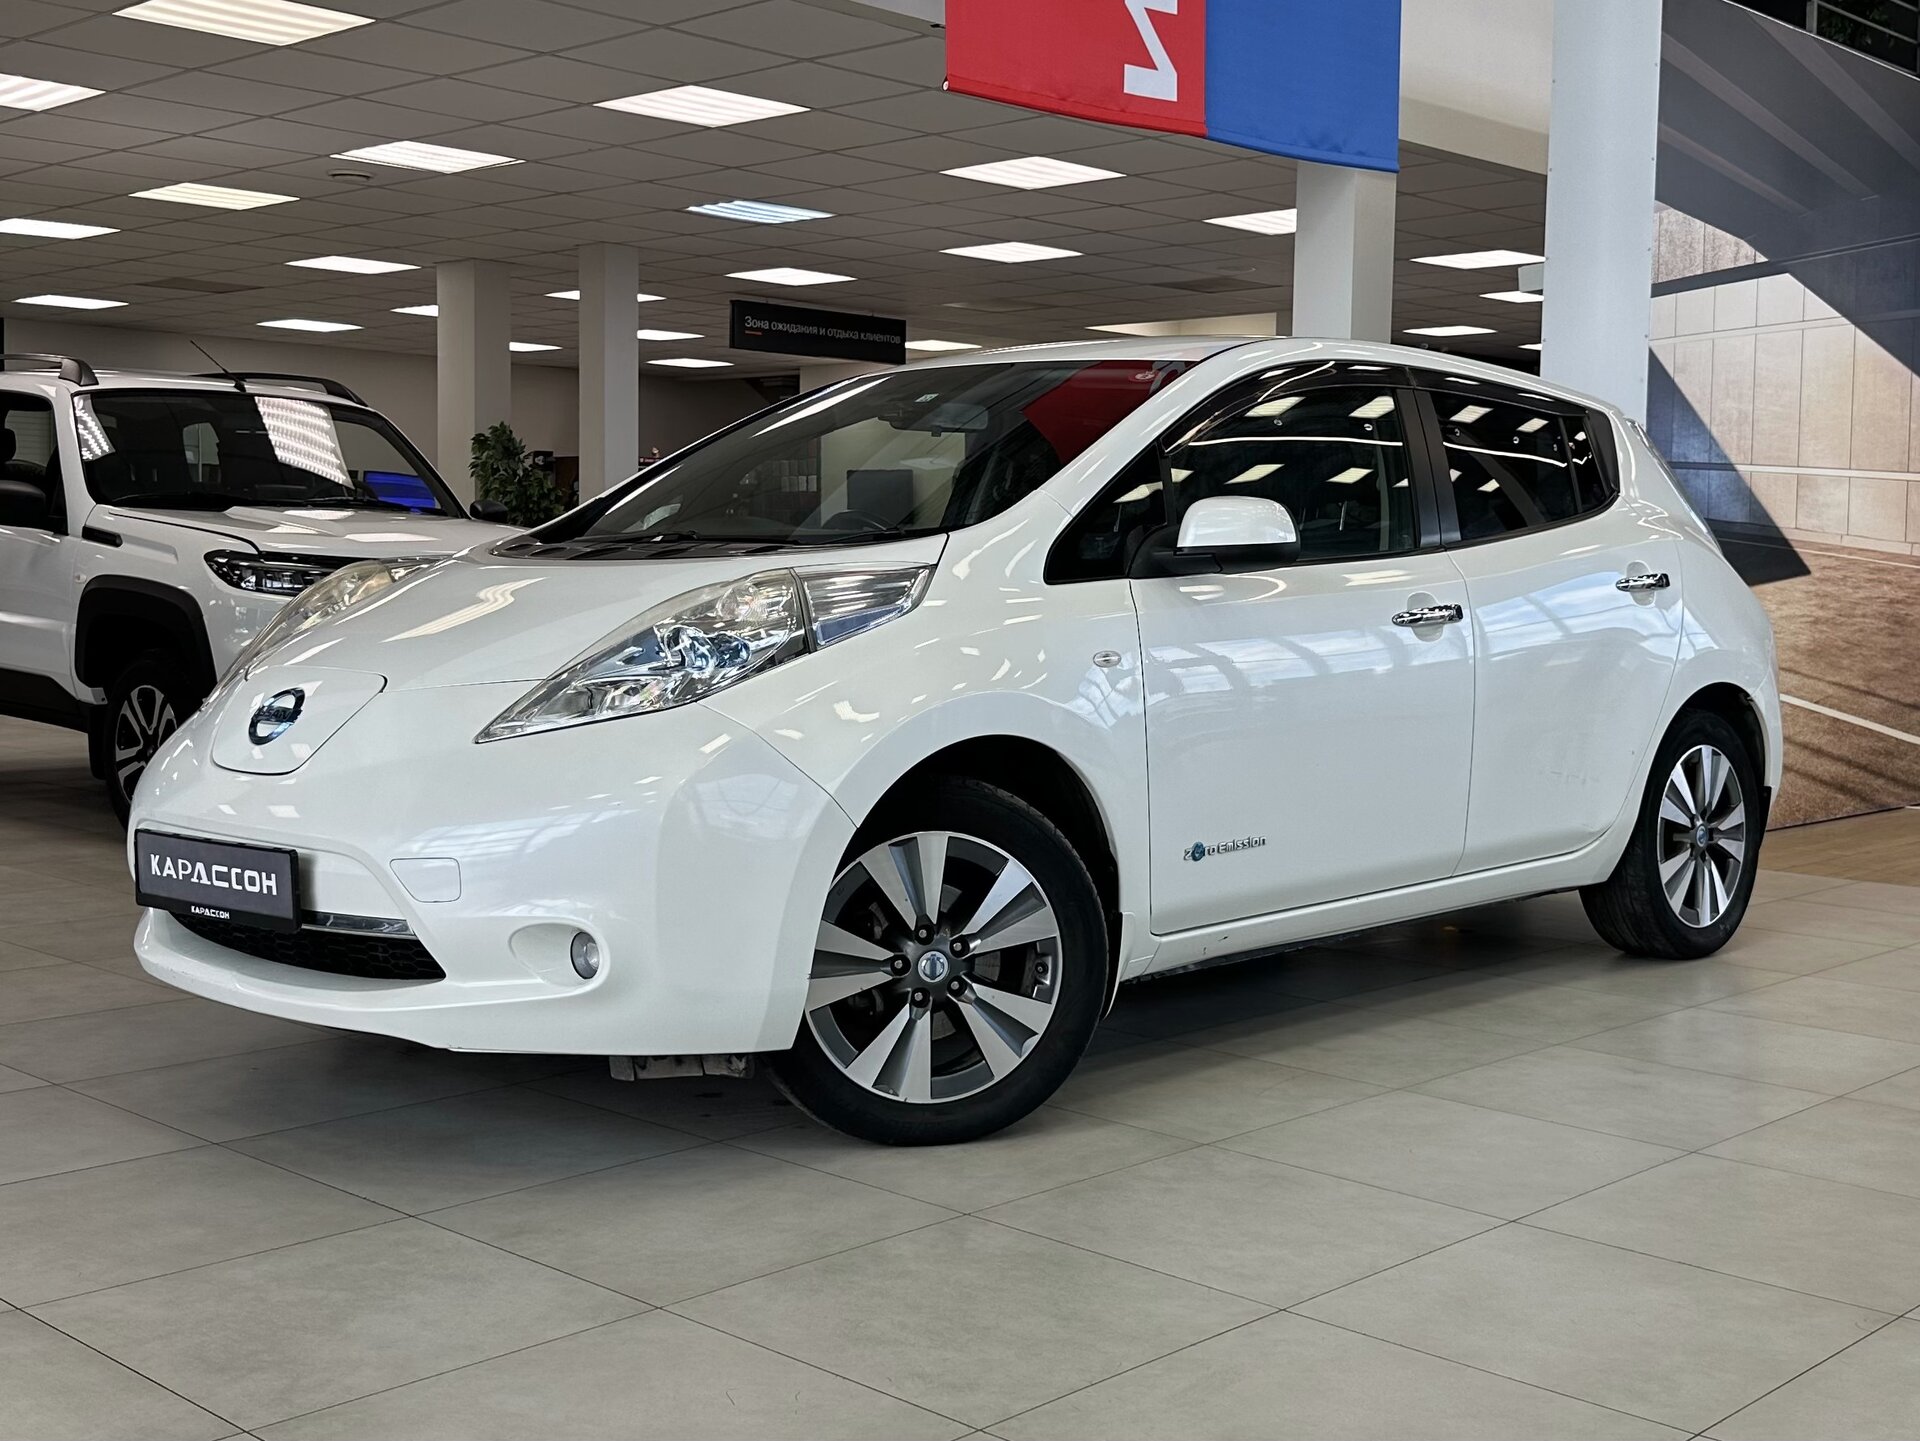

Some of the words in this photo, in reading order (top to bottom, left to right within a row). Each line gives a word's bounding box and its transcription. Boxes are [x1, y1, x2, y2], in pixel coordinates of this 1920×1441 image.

[744, 315, 769, 329] Зона
[771, 321, 818, 335] ожидания
[819, 327, 826, 336] и
[827, 327, 859, 339] отдыха
[860, 332, 901, 344] клиентов
